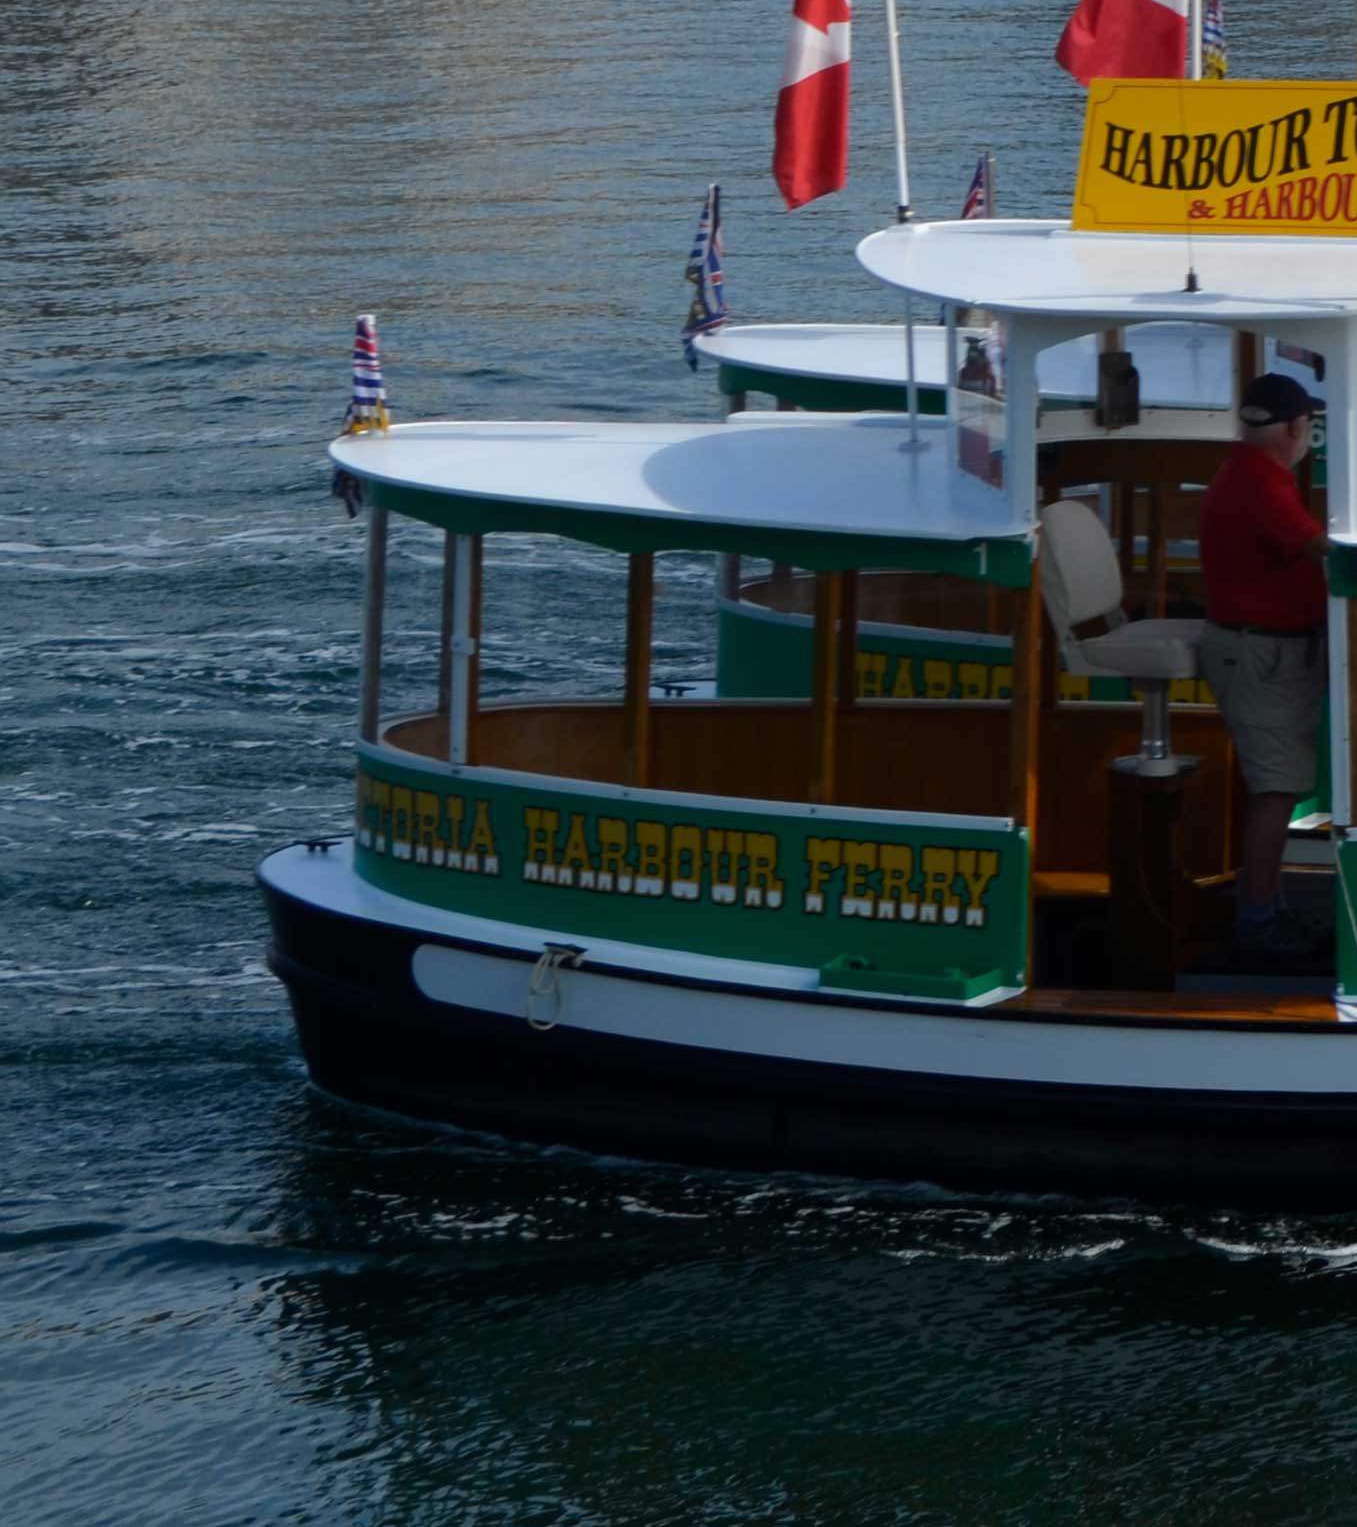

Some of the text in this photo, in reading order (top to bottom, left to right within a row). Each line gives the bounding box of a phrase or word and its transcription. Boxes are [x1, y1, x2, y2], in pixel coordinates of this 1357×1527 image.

[1100, 107, 1312, 191] HARBOUR
[1186, 200, 1215, 220] &
[522, 807, 784, 910] HARBOUR
[804, 836, 1000, 928] FERRY
